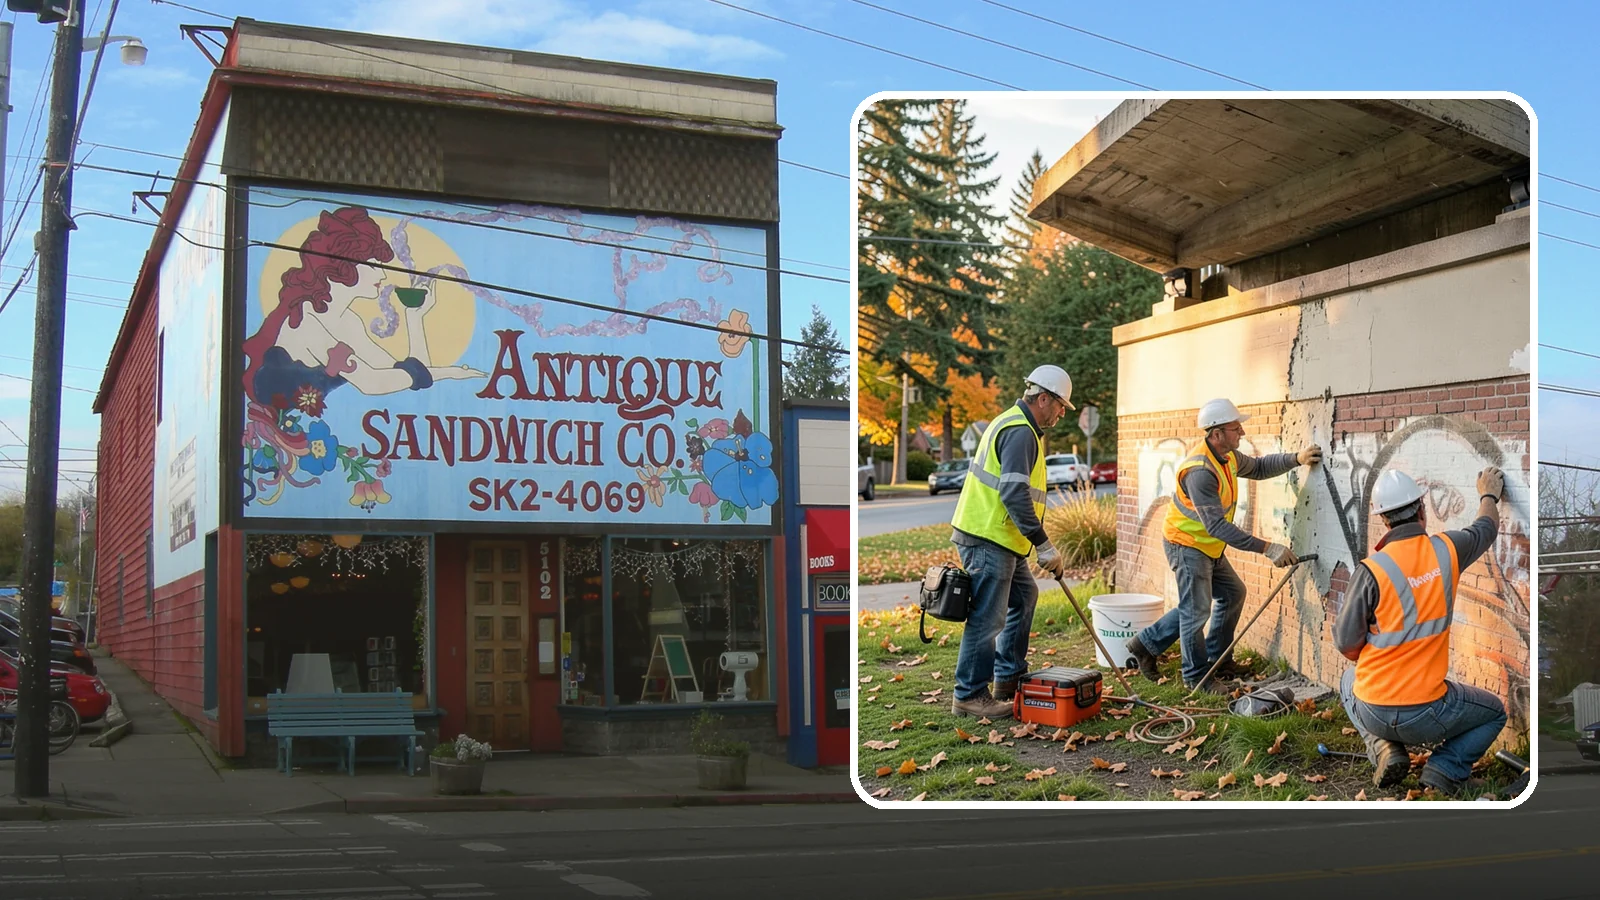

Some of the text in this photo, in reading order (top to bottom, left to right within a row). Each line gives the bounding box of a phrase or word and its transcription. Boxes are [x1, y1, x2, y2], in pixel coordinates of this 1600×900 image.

[475, 329, 724, 421] ANTIQUE
[361, 408, 685, 469] SANDWICH CO.
[468, 477, 646, 513] SK2-4069
[539, 542, 552, 599] 5102
[809, 555, 835, 569] BOOKS
